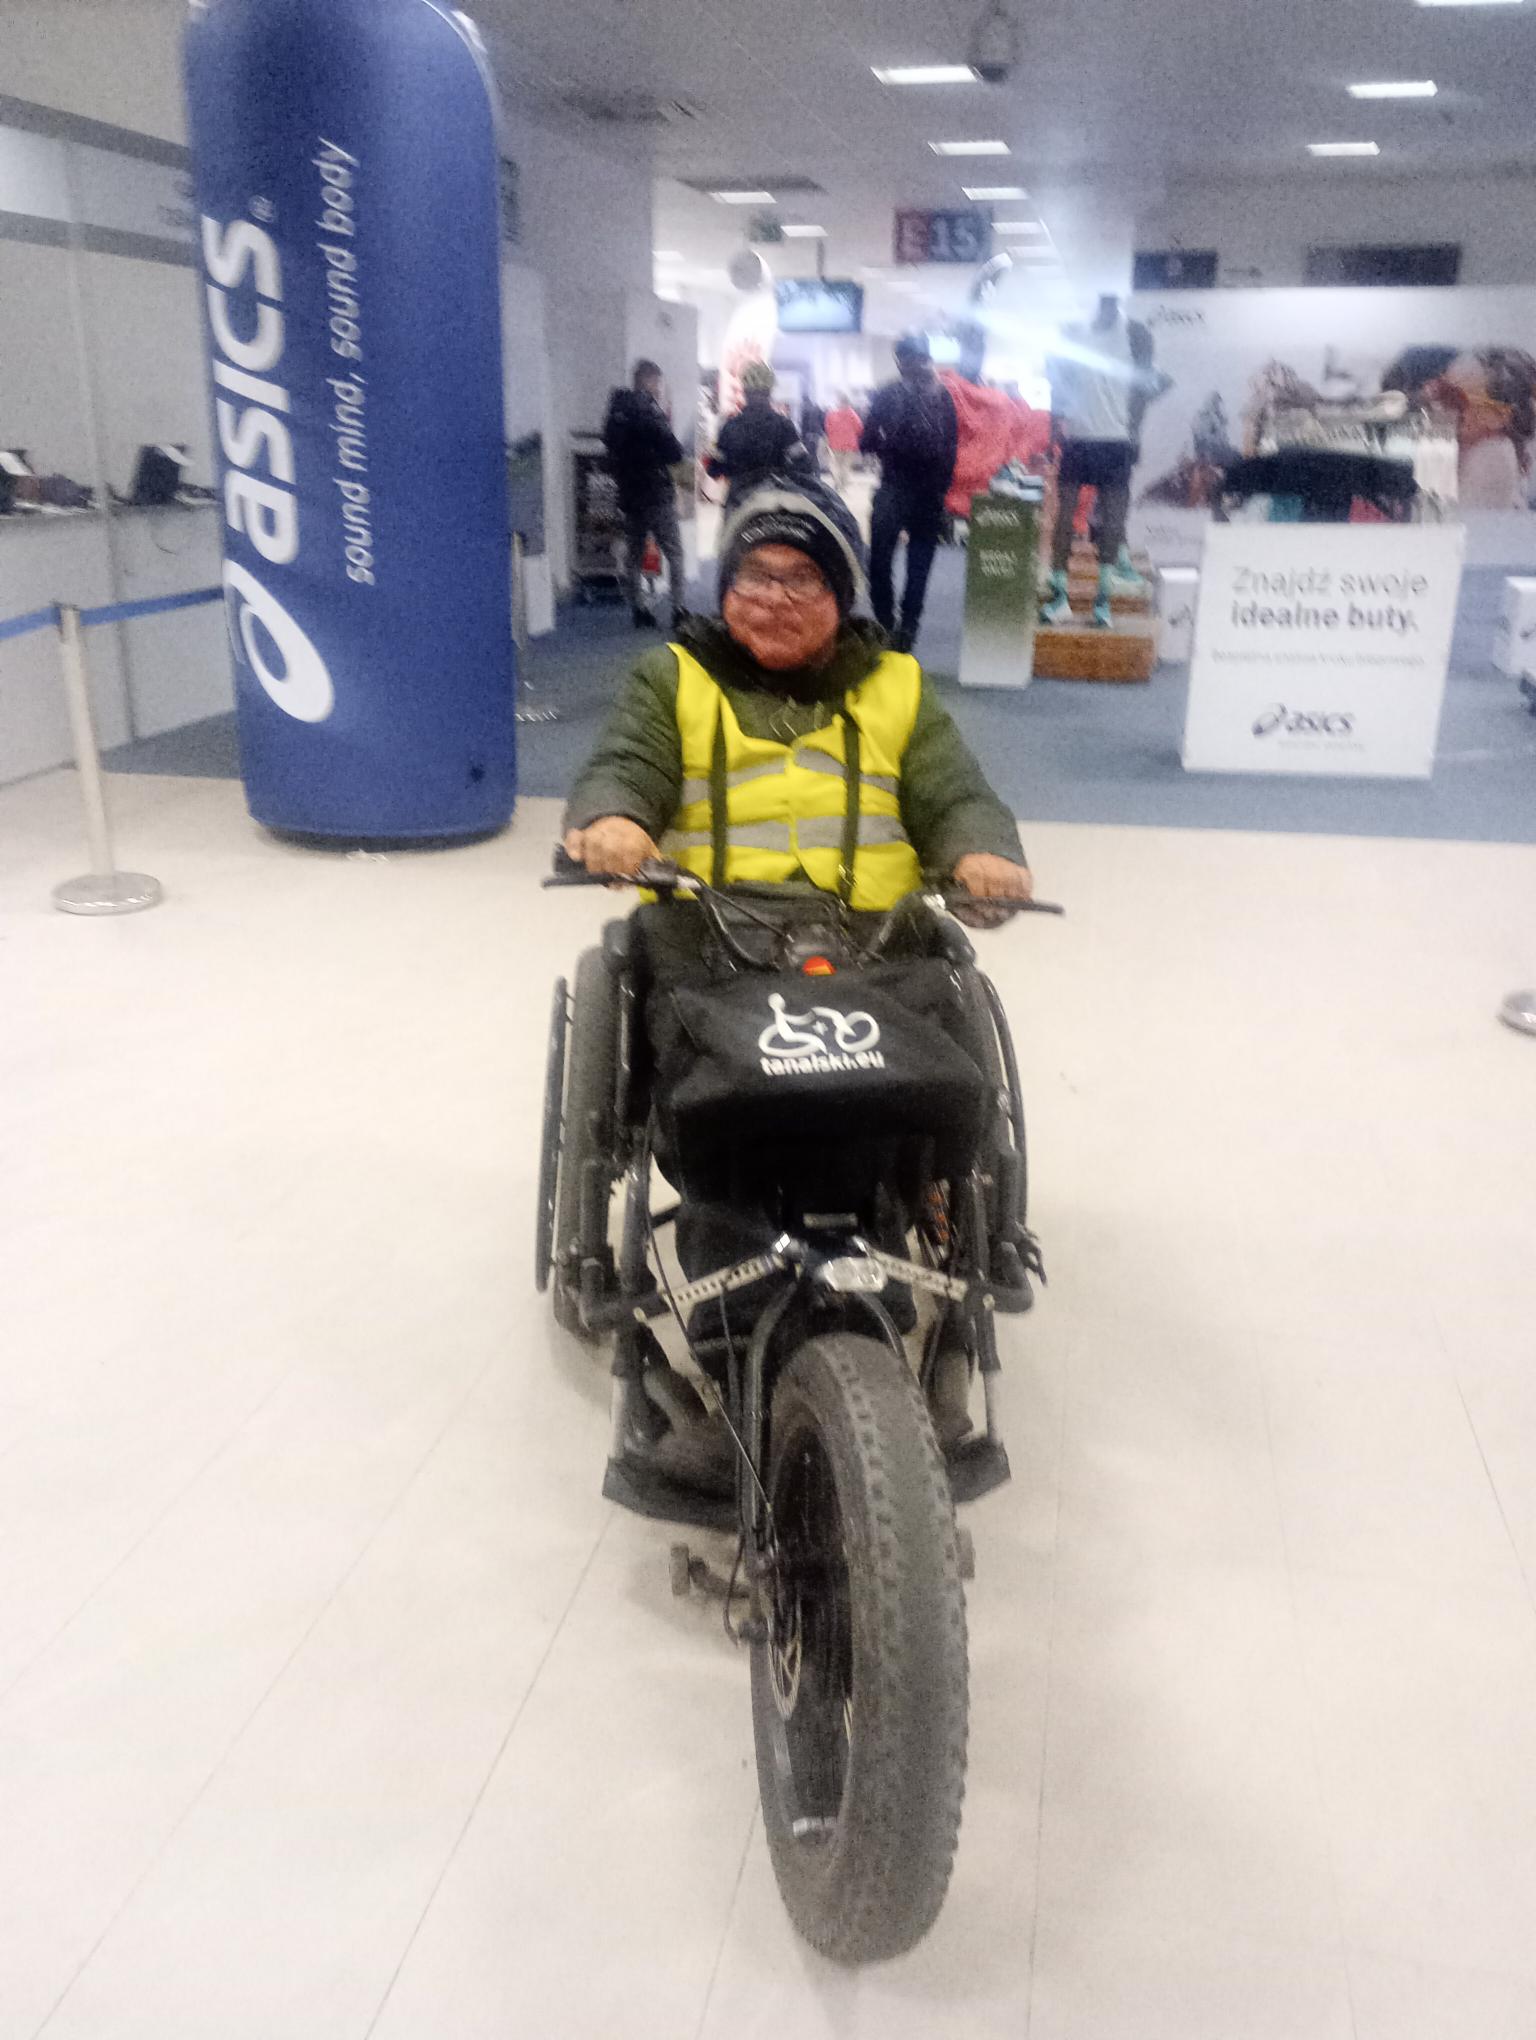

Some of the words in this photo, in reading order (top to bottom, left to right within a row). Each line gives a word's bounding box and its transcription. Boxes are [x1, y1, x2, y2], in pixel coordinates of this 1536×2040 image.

[311, 136, 360, 236] body
[316, 242, 363, 361] sound
[201, 213, 299, 566] asics
[325, 371, 369, 472] mind,
[331, 477, 375, 586] sound
[1230, 599, 1340, 629] idealne
[1339, 568, 1430, 600] swoje
